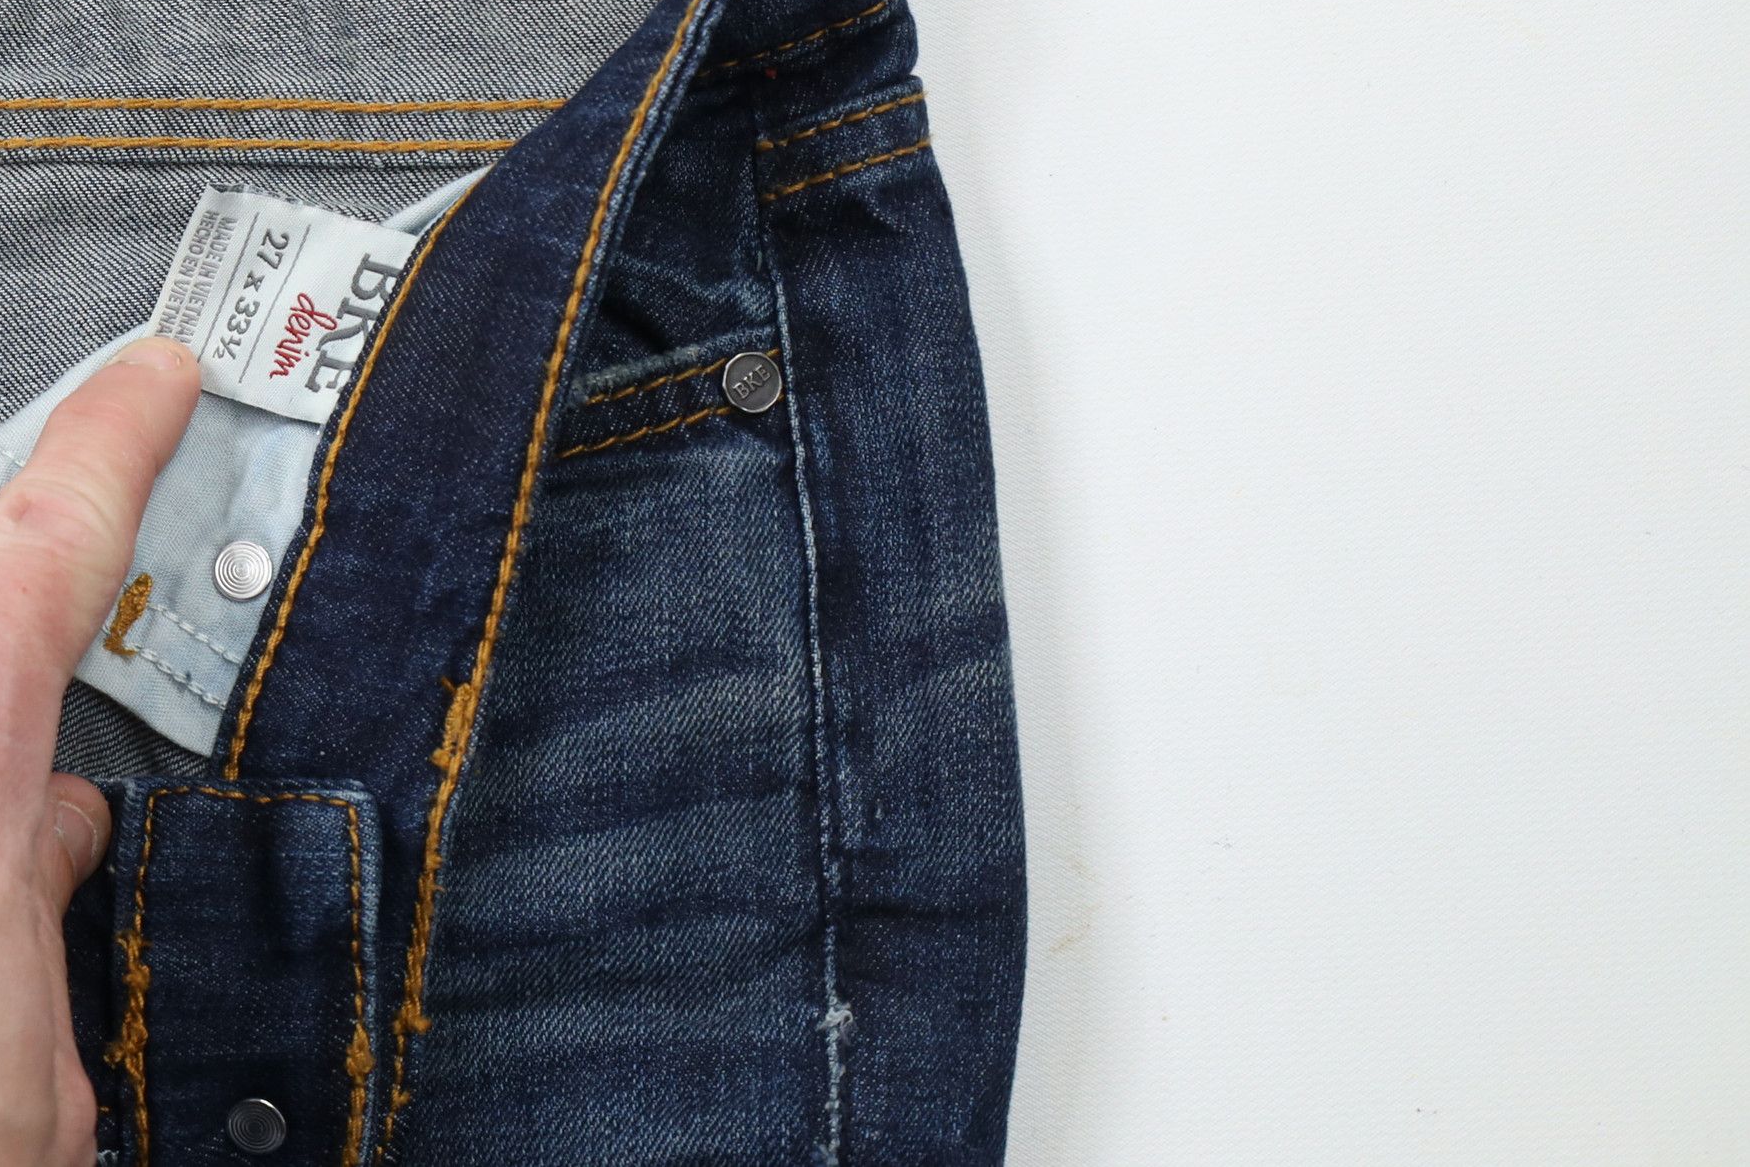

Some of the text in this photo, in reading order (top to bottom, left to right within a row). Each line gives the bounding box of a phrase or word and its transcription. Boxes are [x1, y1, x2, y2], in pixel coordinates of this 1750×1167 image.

[205, 215, 238, 263] MADE
[256, 228, 291, 271] 27
[153, 209, 220, 338] HECHO EN VIETNA
[197, 259, 221, 280] IN
[267, 291, 339, 380] denim
[304, 252, 403, 394] BKE
[732, 364, 771, 400] BKE
